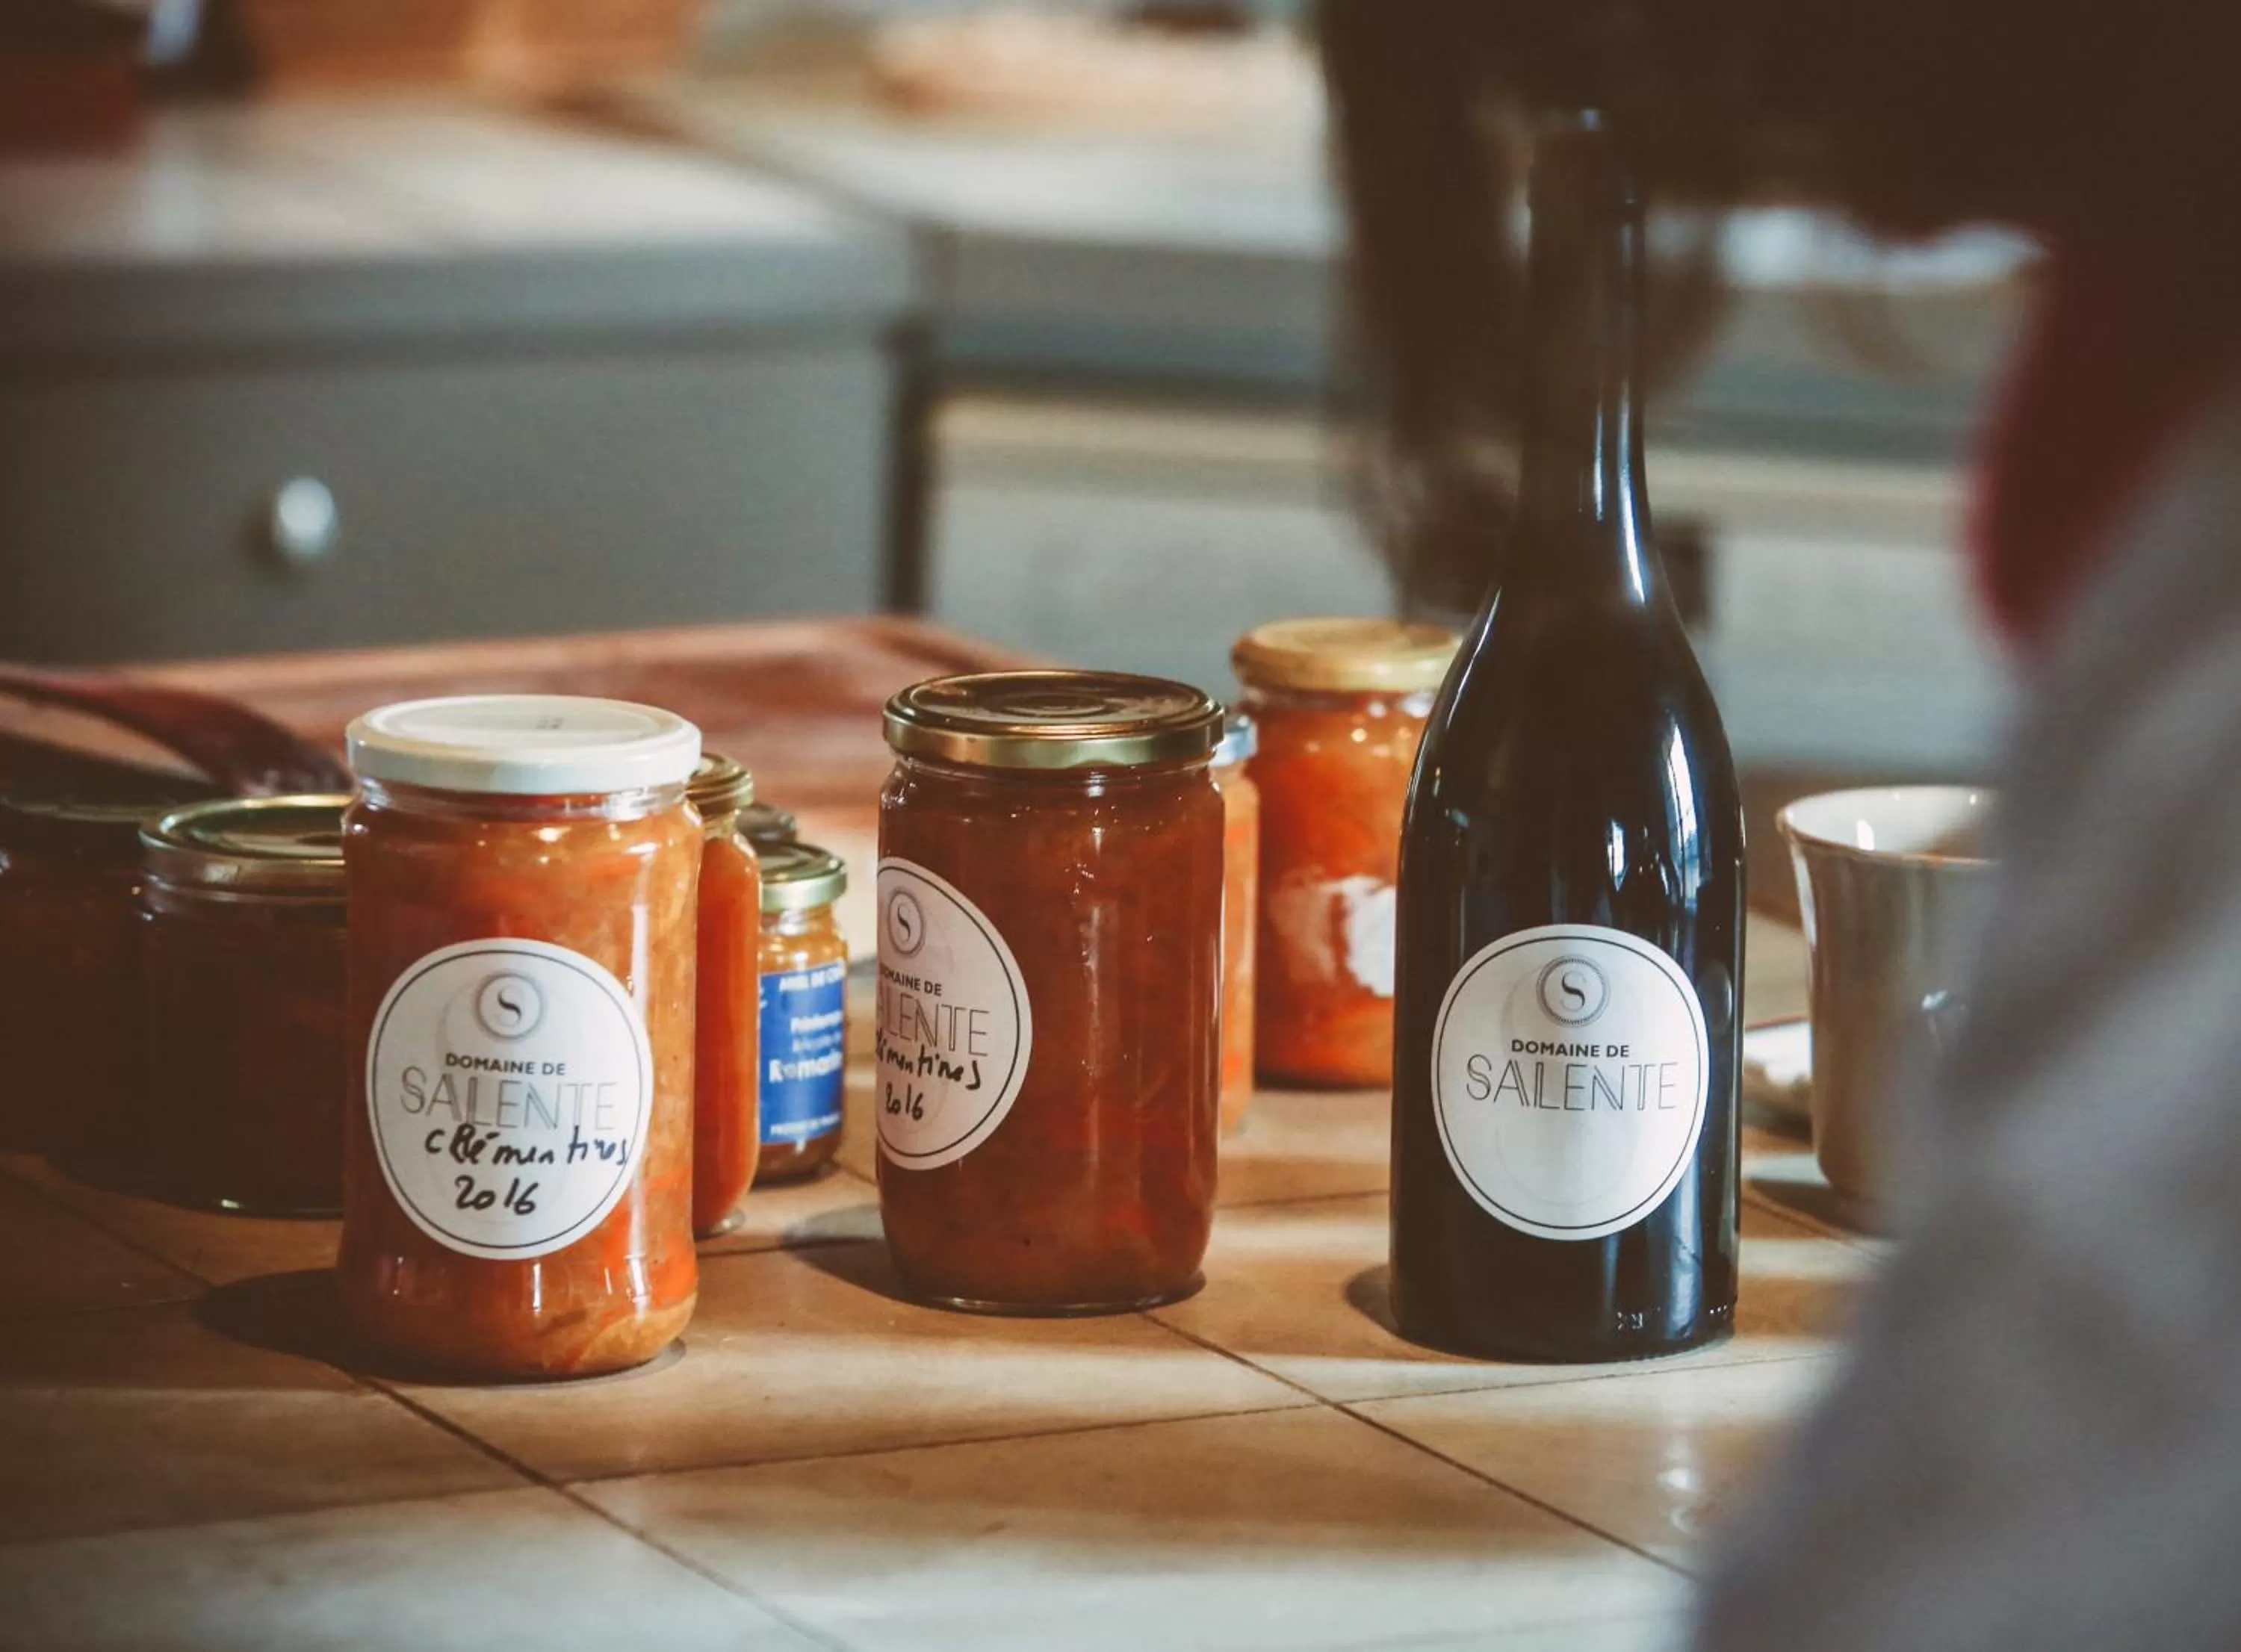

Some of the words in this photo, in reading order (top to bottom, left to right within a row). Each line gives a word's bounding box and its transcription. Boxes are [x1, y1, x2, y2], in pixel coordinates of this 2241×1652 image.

[924, 981, 942, 996] DE
[1560, 970, 1587, 1013] S
[445, 1052, 535, 1074] DOMAINE
[542, 1062, 566, 1075] DE
[1511, 1039, 1600, 1058] DOMAINE
[1607, 1044, 1630, 1058] DE
[400, 1066, 618, 1131] SALENTE
[886, 1082, 924, 1120] 2016
[1466, 1054, 1679, 1111] SALENTE
[454, 1175, 539, 1216] 2016
